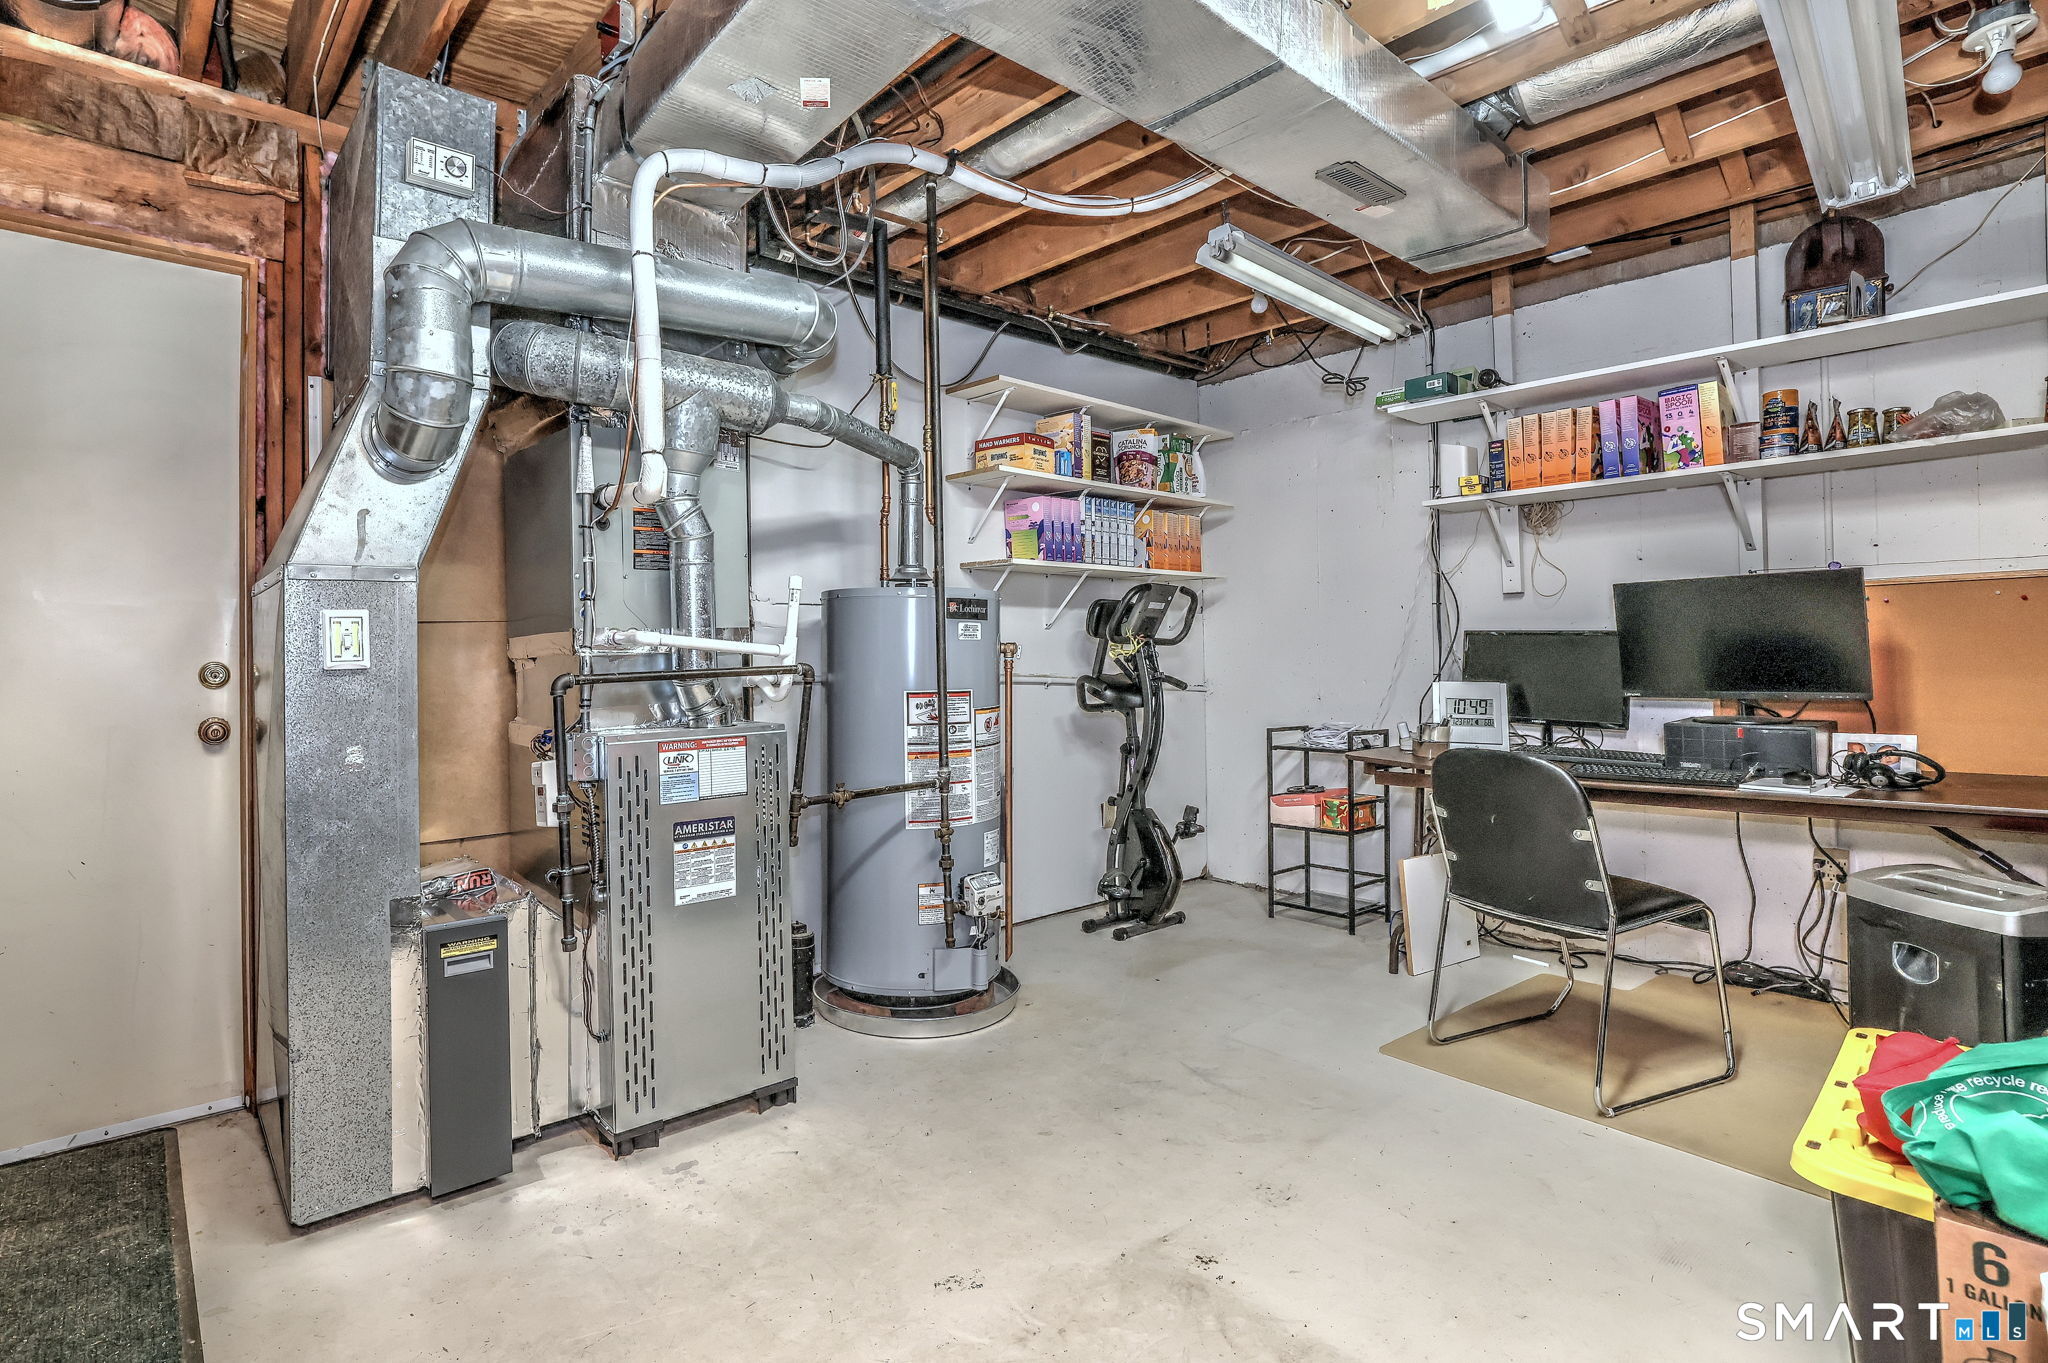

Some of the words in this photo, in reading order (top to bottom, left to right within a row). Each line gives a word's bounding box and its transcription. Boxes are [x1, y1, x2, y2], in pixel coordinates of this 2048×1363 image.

[1665, 393, 1692, 403] MAGIC
[1665, 399, 1693, 409] SPOON
[993, 437, 1020, 446] WARMERS
[1118, 438, 1148, 448] CATALINA
[1454, 699, 1488, 715] 10:49
[662, 742, 698, 751] WARNING:
[667, 755, 690, 764] LINK
[675, 819, 734, 836] AMERISTAR
[447, 936, 491, 947] WARNING
[1966, 1075, 2025, 1087] recycle
[2029, 1081, 2048, 1095] re
[1972, 1241, 2010, 1287] 6
[1946, 1277, 1954, 1293] 1
[1964, 1283, 2043, 1322] GALLN
